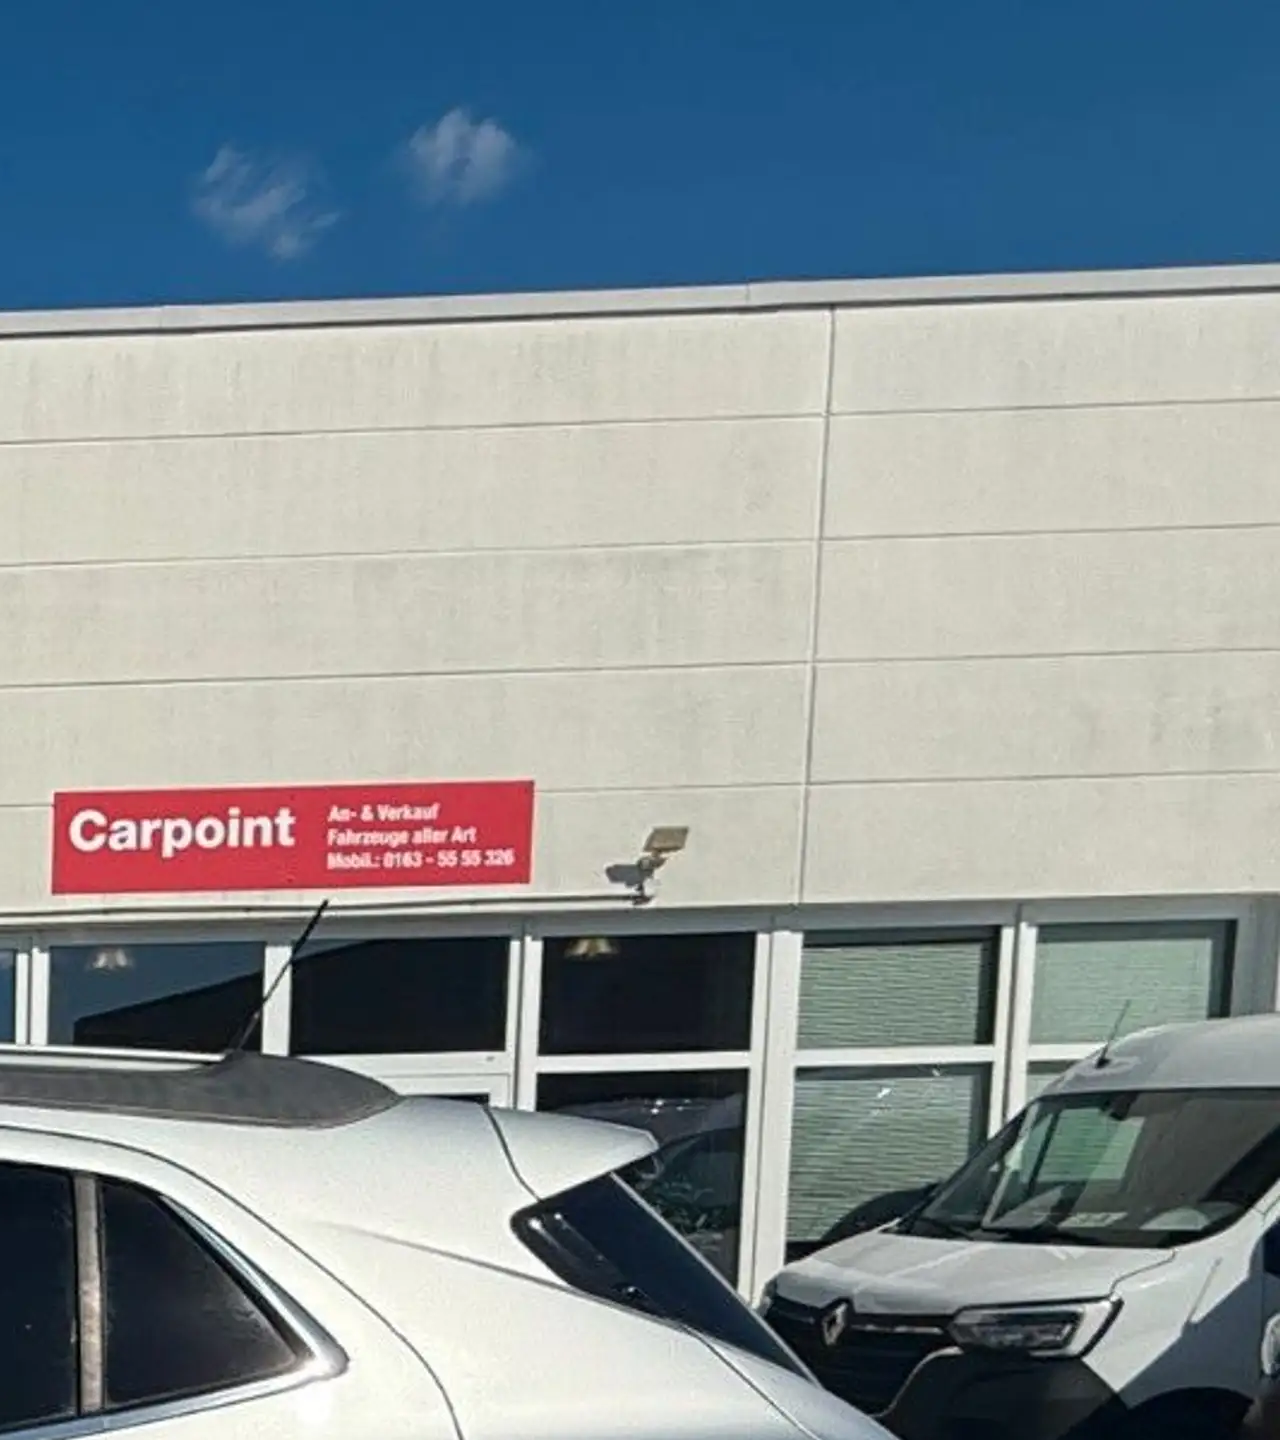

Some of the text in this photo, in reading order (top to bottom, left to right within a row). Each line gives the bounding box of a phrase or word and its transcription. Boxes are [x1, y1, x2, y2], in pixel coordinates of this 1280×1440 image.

[328, 803, 439, 822] An- & Verkauf
[69, 806, 296, 858] Carpoint
[327, 826, 476, 847] Fahrzeuge aller Art
[383, 851, 423, 868] 0163
[437, 850, 458, 867] 55
[461, 849, 482, 866] 55
